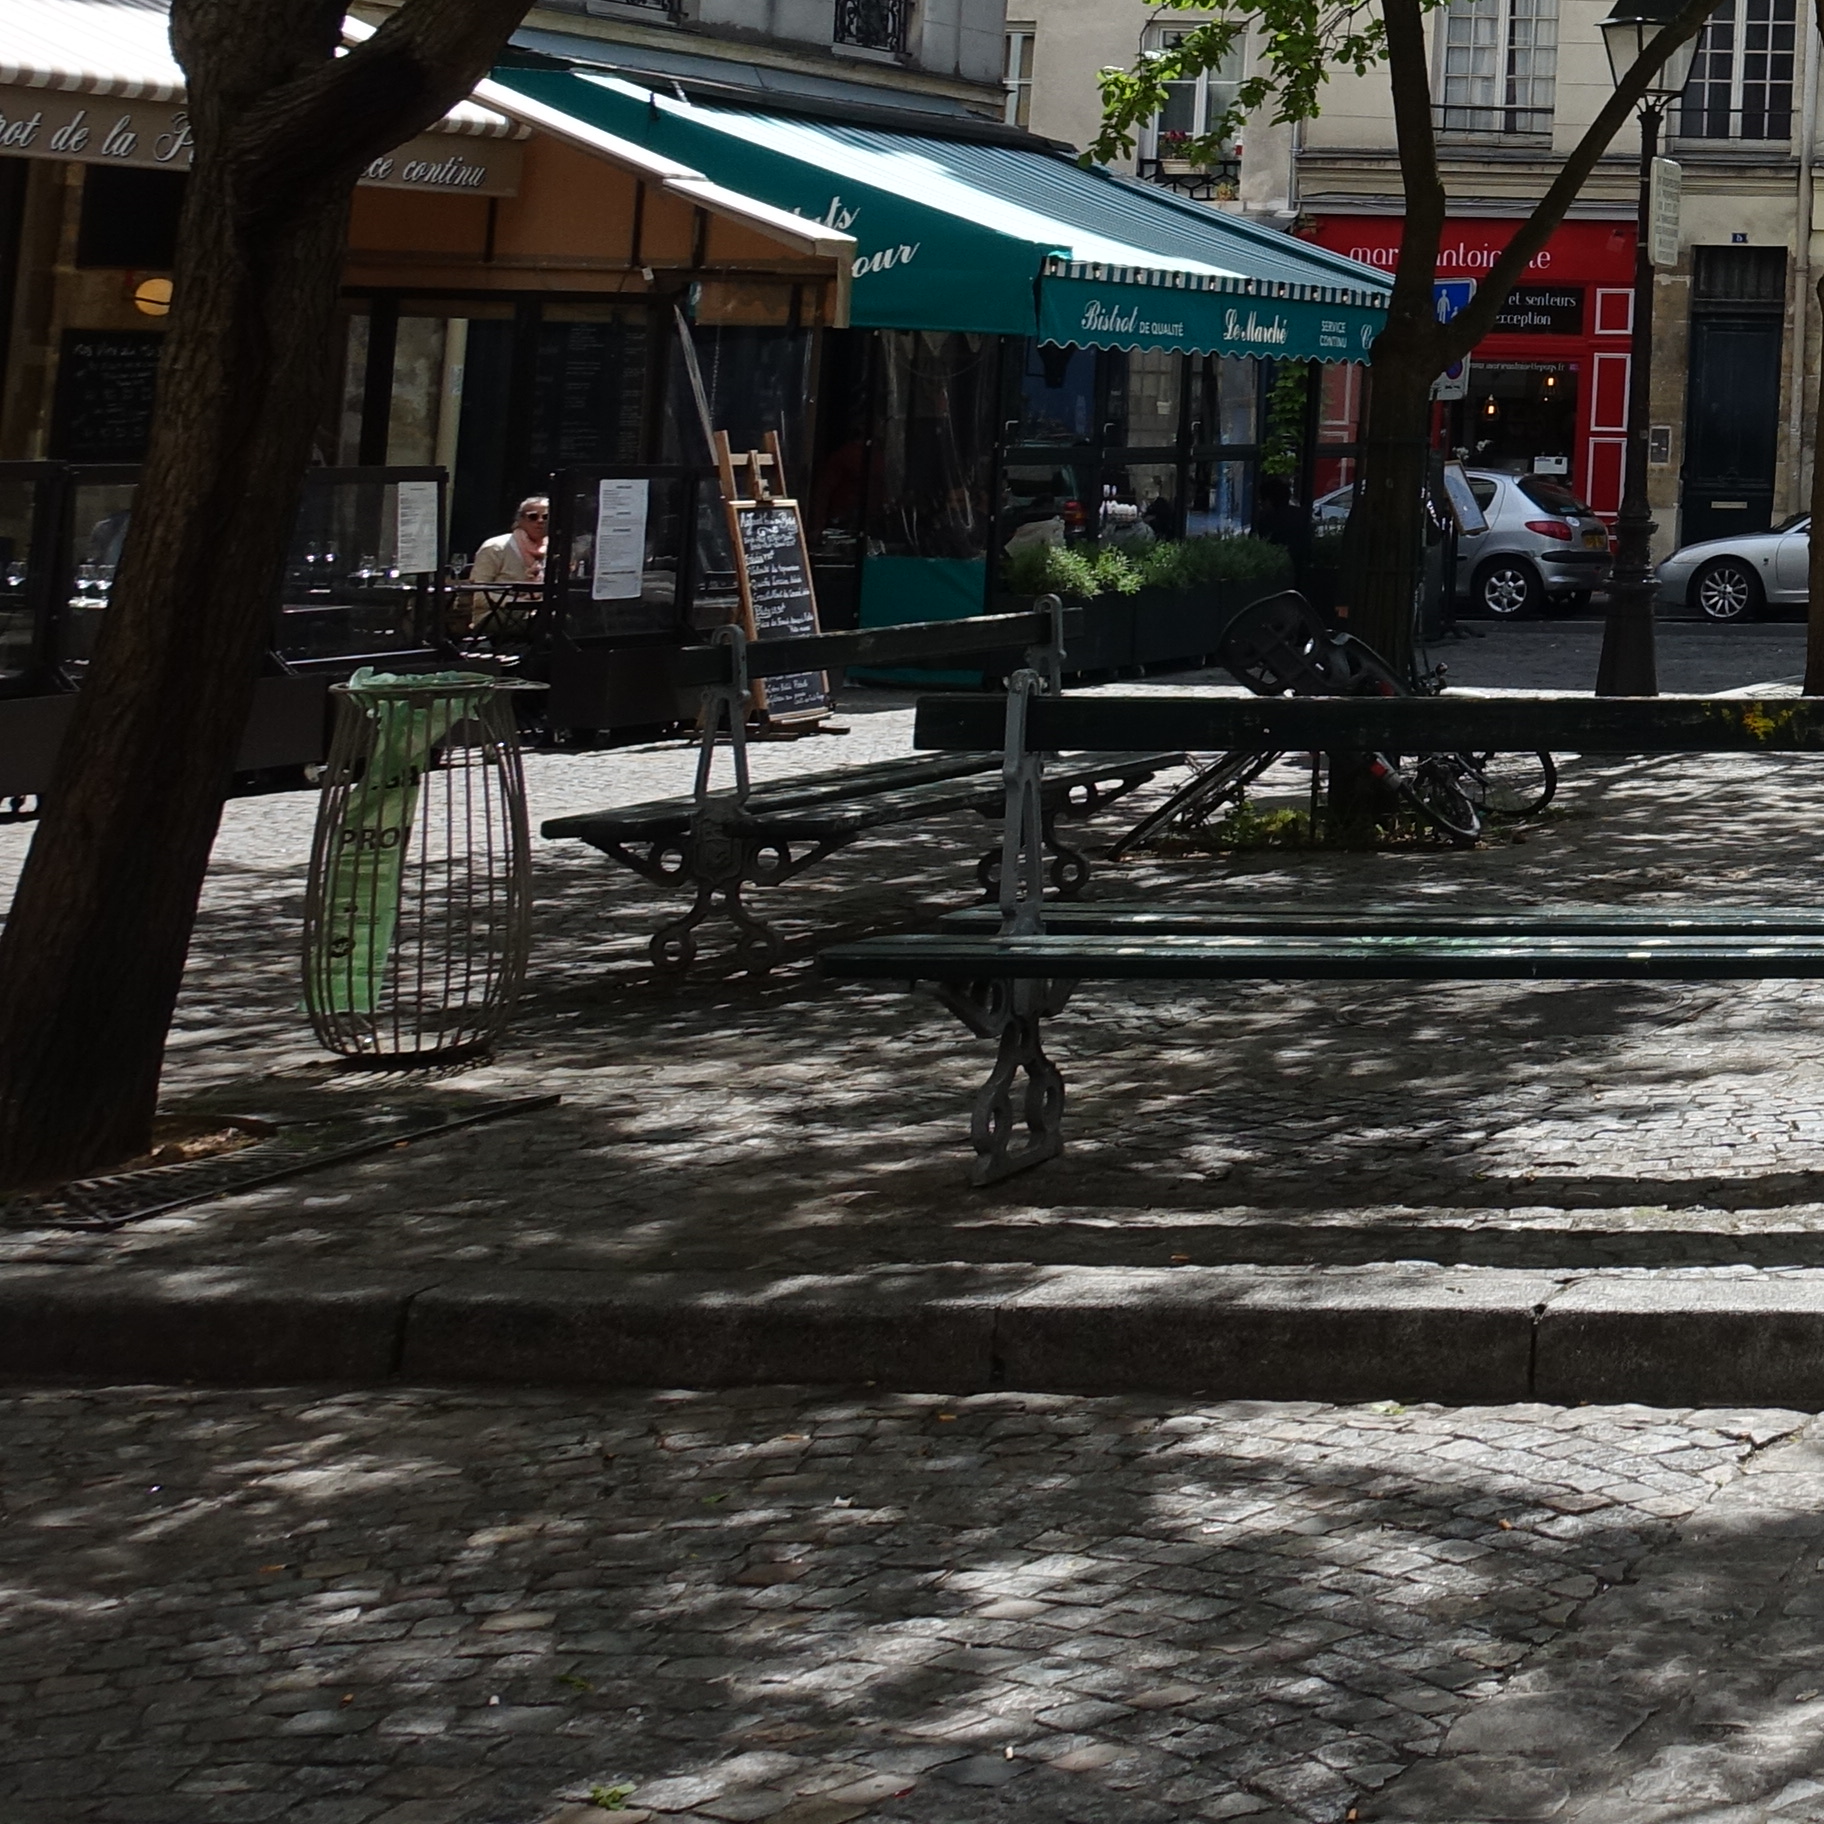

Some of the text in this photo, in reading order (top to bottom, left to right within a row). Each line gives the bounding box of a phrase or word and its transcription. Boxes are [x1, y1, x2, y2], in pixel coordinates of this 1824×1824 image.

[51, 110, 91, 152] de
[101, 114, 137, 157] la
[402, 156, 487, 187] continu
[851, 242, 922, 278] our
[1350, 246, 1399, 266] mar
[1508, 291, 1577, 307] et senteurs
[1081, 299, 1184, 337] Bistrot DE QUALITÉ
[1223, 308, 1288, 344] Le Marché
[1321, 320, 1347, 334] SERVICE
